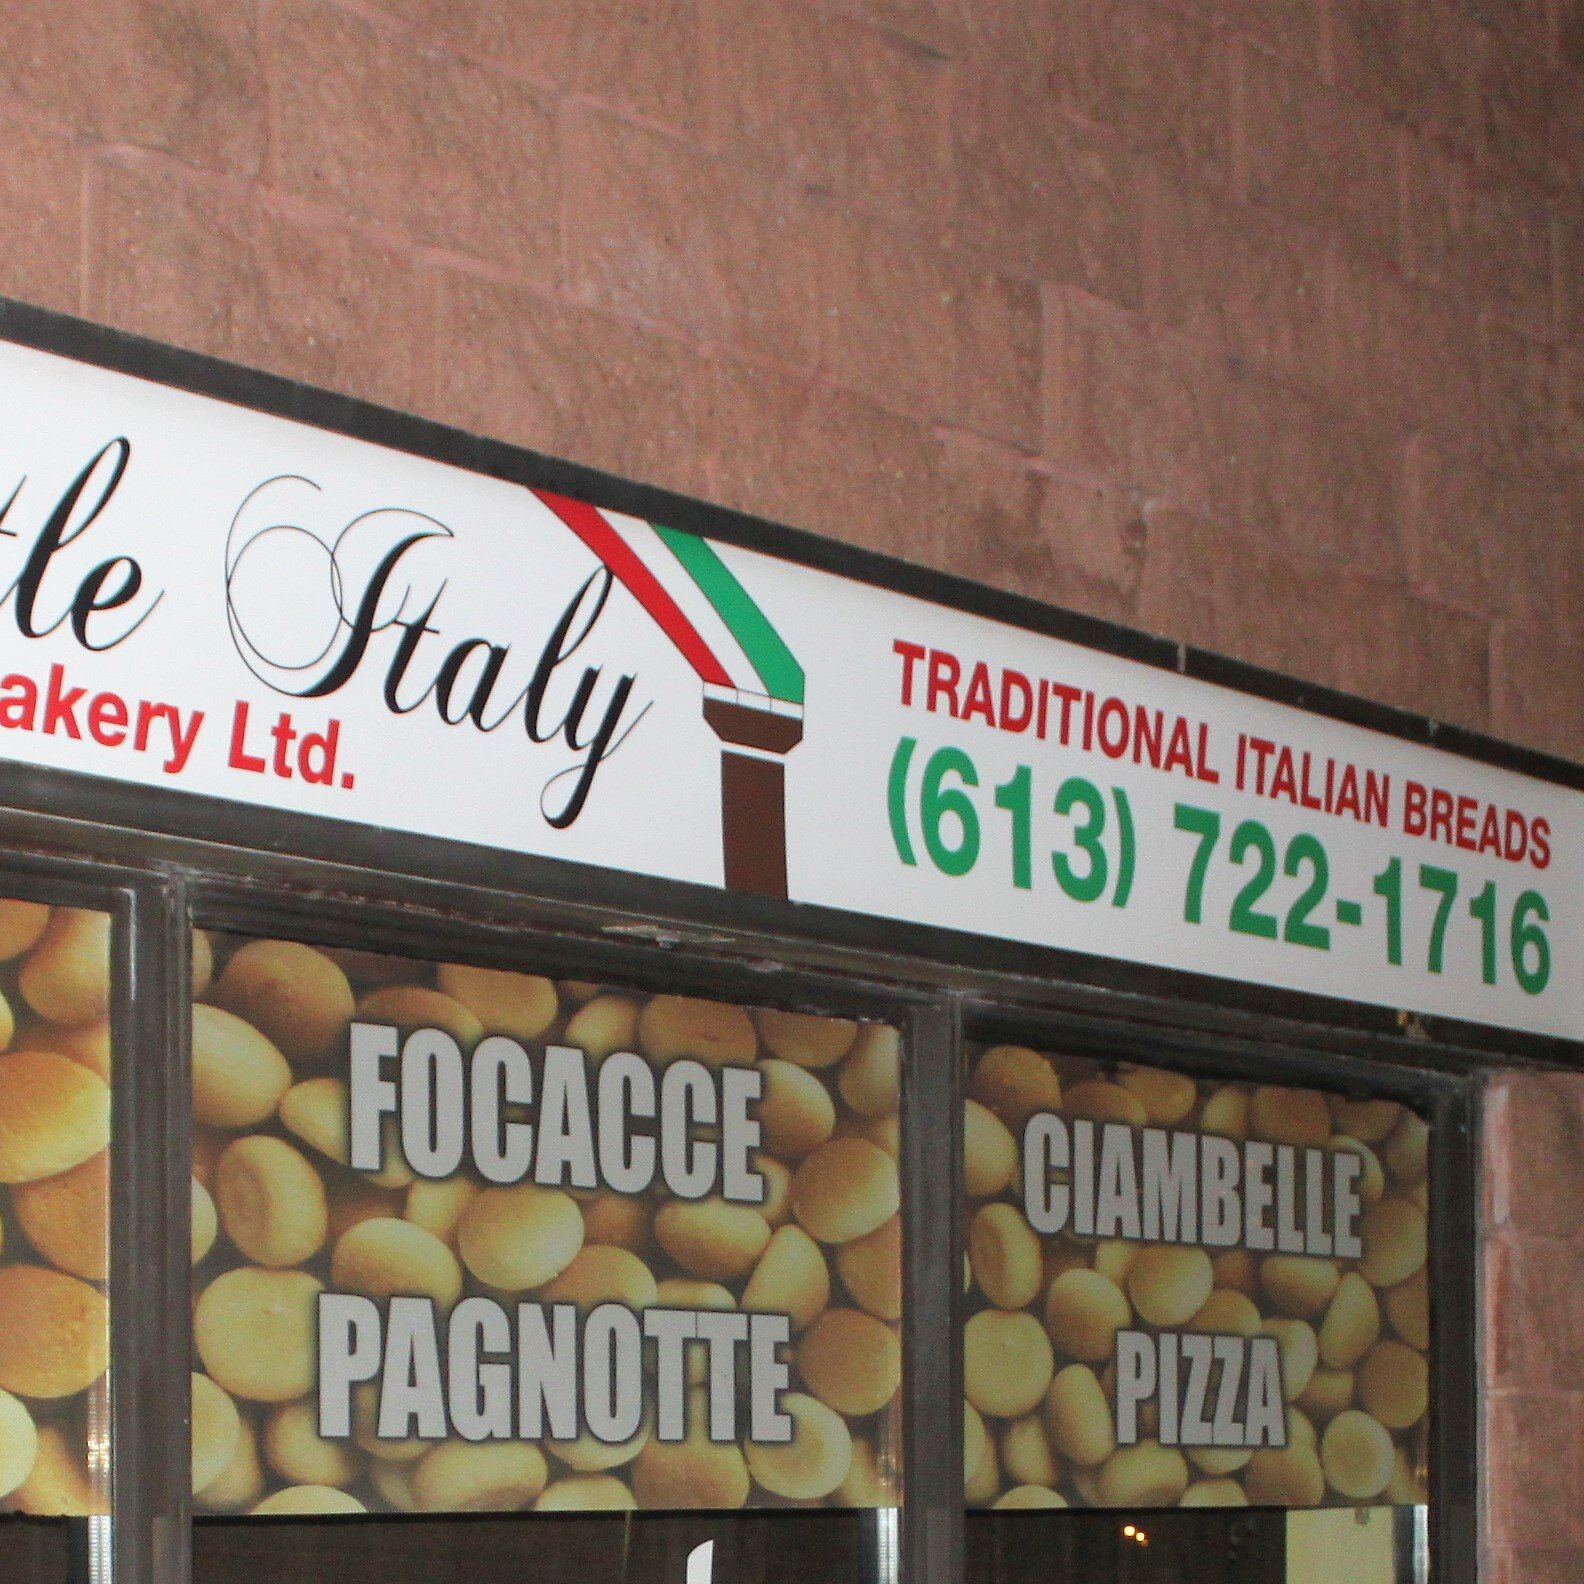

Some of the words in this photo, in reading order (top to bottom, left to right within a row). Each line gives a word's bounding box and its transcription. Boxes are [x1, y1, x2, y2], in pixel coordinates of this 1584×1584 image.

[225, 474, 653, 829] Italy
[228, 700, 357, 790] Ltd.
[892, 639, 1218, 784] TRADITIONAL
[1235, 732, 1390, 827] ITALIAN
[1403, 781, 1552, 870] BREADS
[886, 736, 1136, 909] (613)
[1173, 803, 1552, 996] 722-1716
[349, 1022, 764, 1202] FOCACCE
[1022, 1112, 1363, 1259] CIAMBELLE
[318, 1293, 792, 1444] PAGNOTTE
[1116, 1331, 1287, 1447] PIZZA
